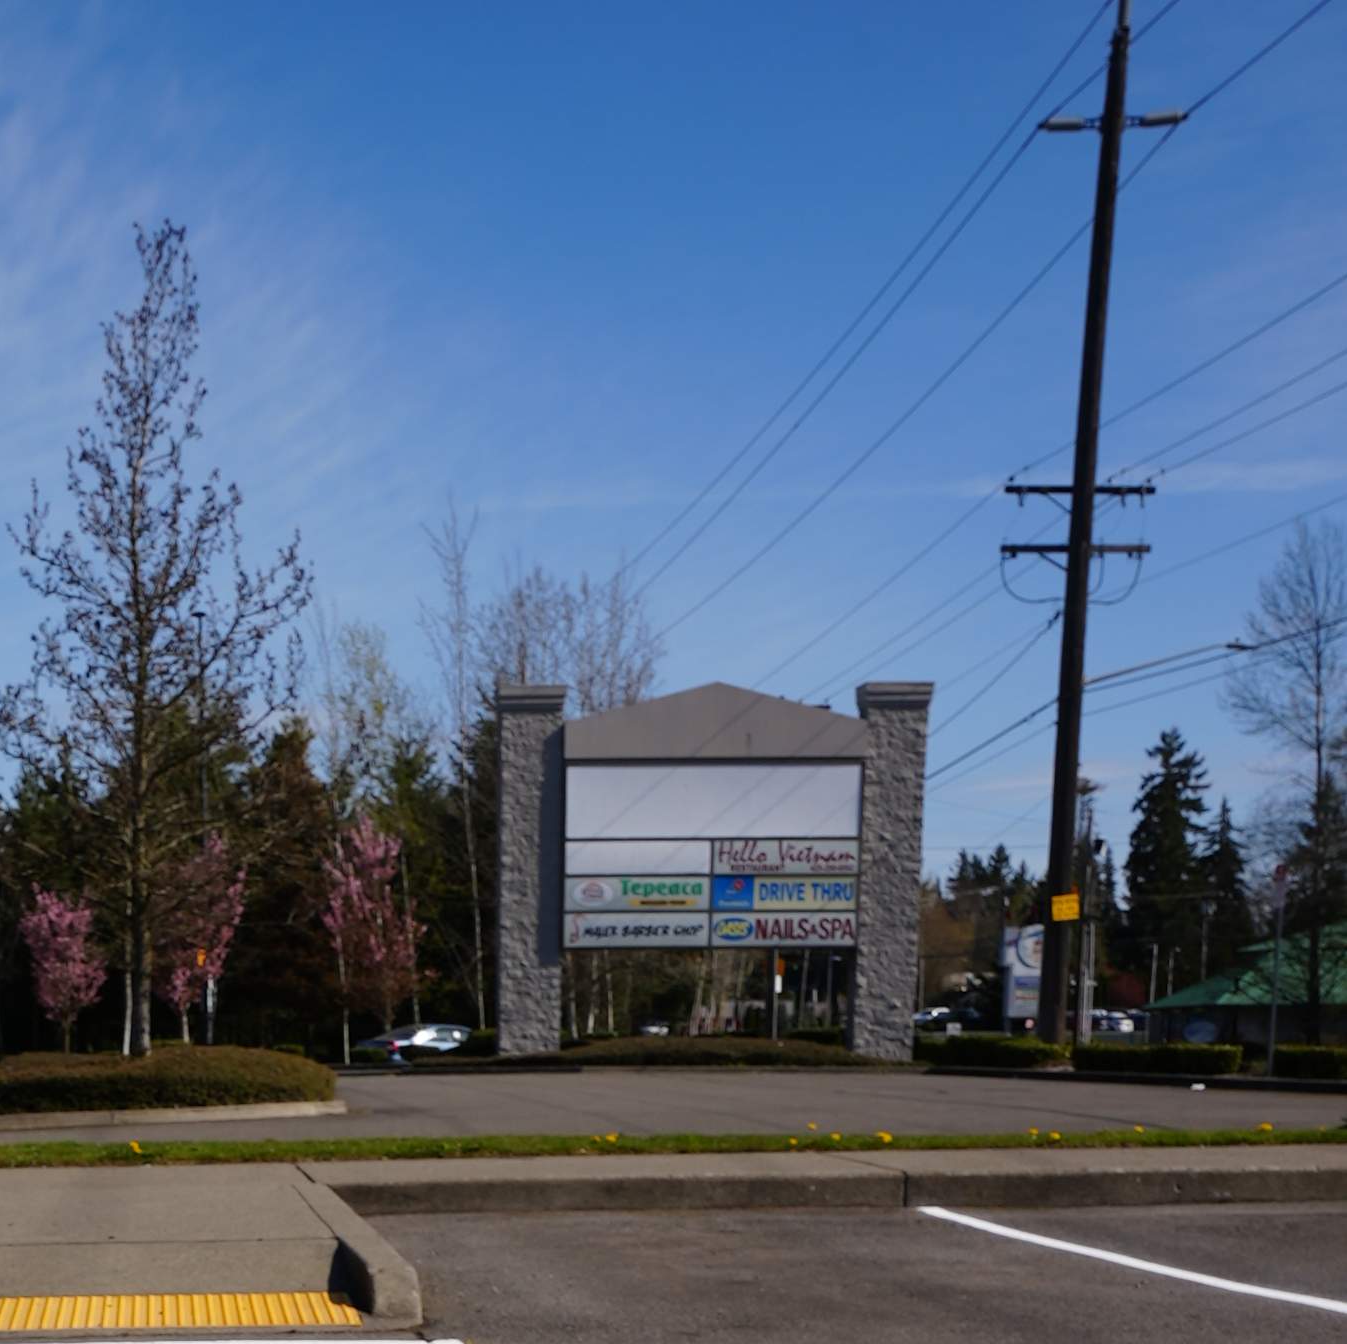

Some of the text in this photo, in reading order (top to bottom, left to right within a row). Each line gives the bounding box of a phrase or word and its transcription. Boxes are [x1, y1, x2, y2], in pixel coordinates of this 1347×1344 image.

[718, 840, 855, 868] Hello Vietnam
[621, 879, 702, 897] Tepeaca
[759, 882, 854, 901] DRIVE THRU
[621, 924, 670, 938] BARBER
